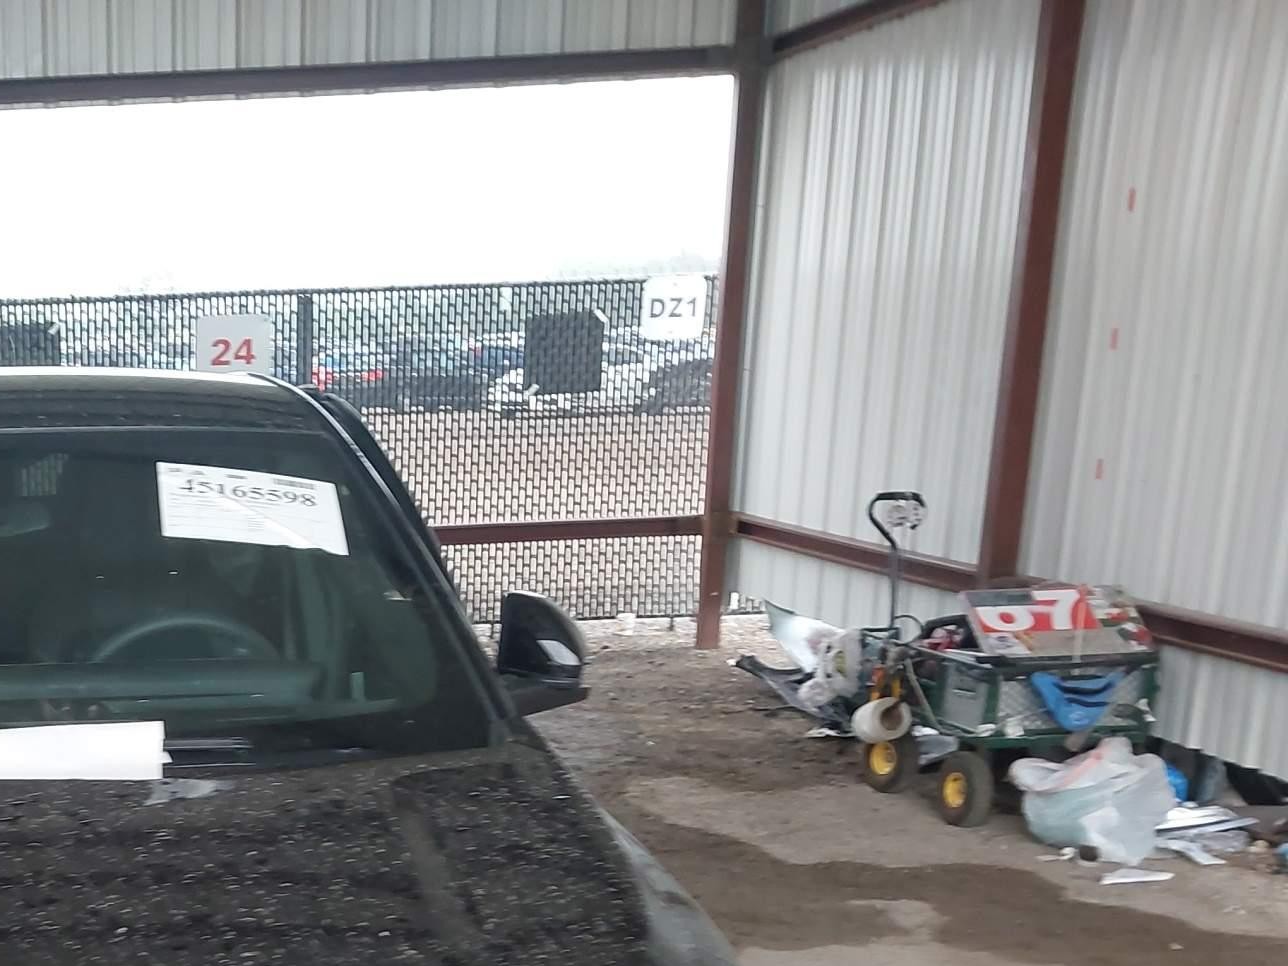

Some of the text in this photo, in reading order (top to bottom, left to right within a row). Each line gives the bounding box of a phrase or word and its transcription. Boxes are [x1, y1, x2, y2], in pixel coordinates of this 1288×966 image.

[650, 297, 696, 318] DZ1
[211, 338, 256, 366] 24
[178, 478, 318, 507] 45165598
